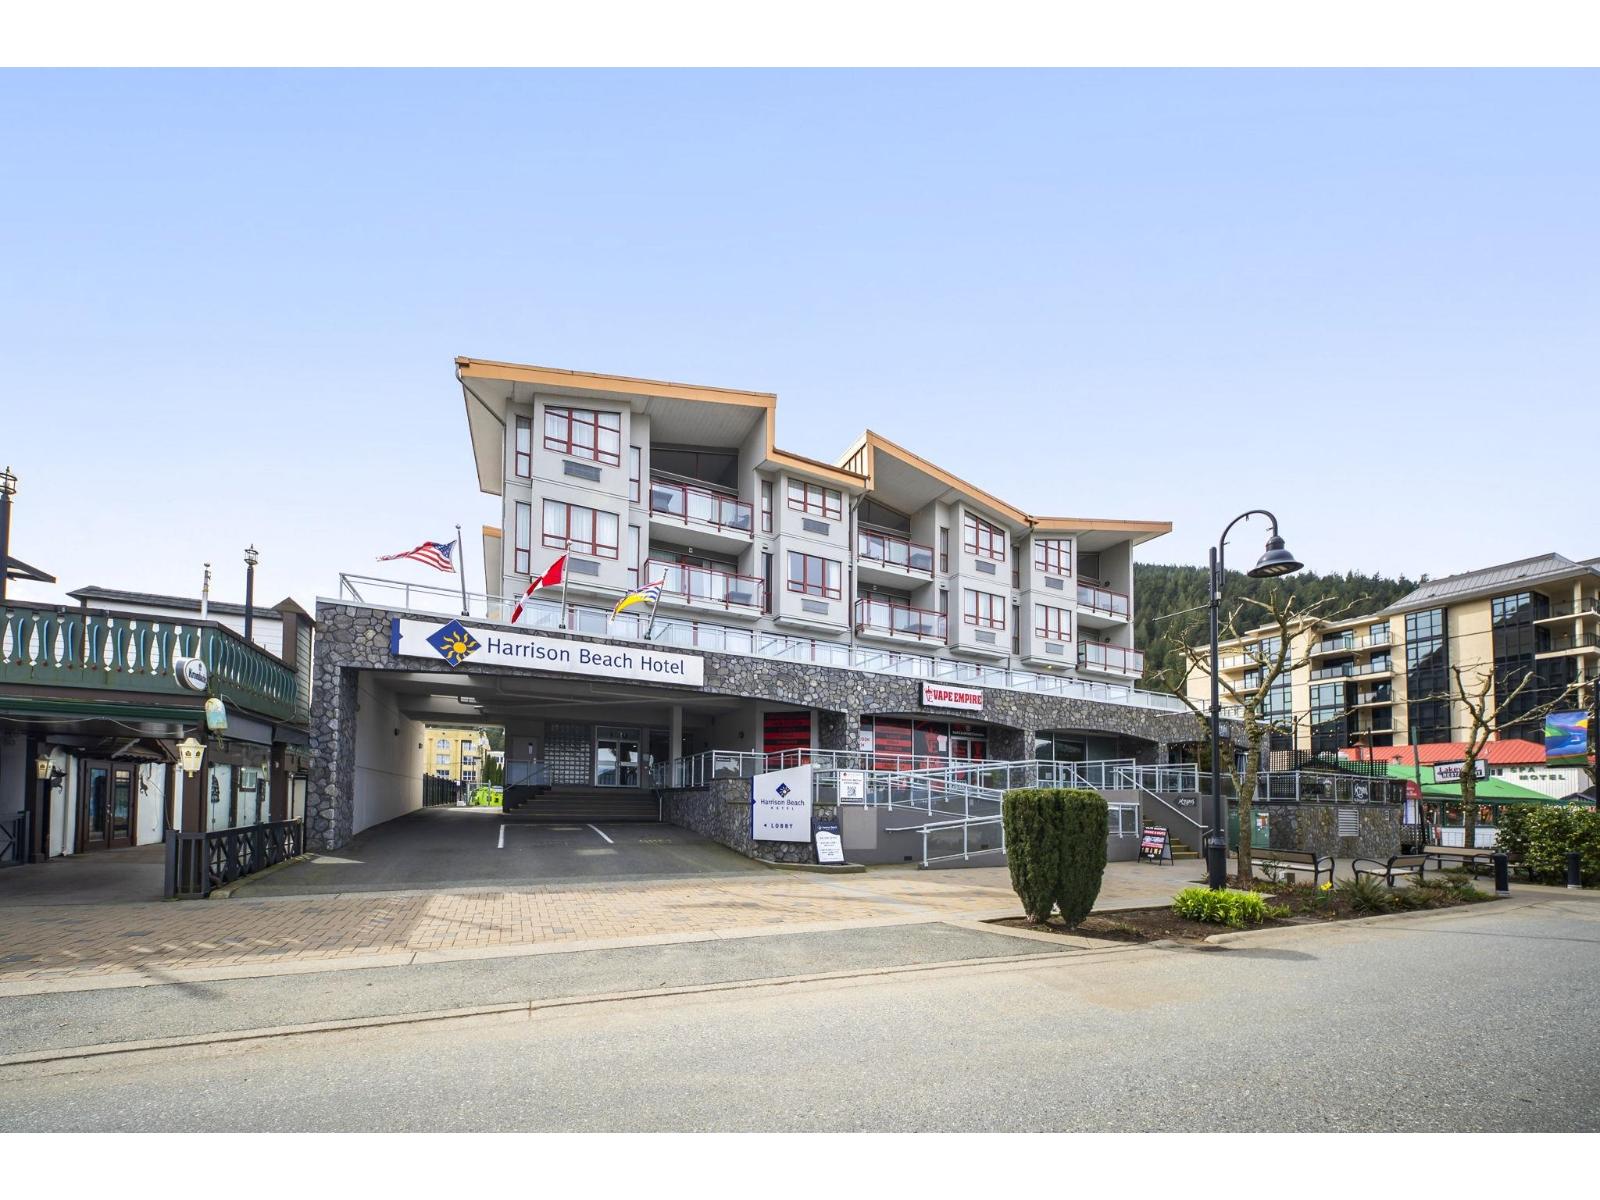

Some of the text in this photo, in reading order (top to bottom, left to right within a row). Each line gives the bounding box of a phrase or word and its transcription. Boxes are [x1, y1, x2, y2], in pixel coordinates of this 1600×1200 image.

[487, 637, 685, 675] Harrison Beach Hotel
[933, 690, 982, 704] VAPE EMPIRE
